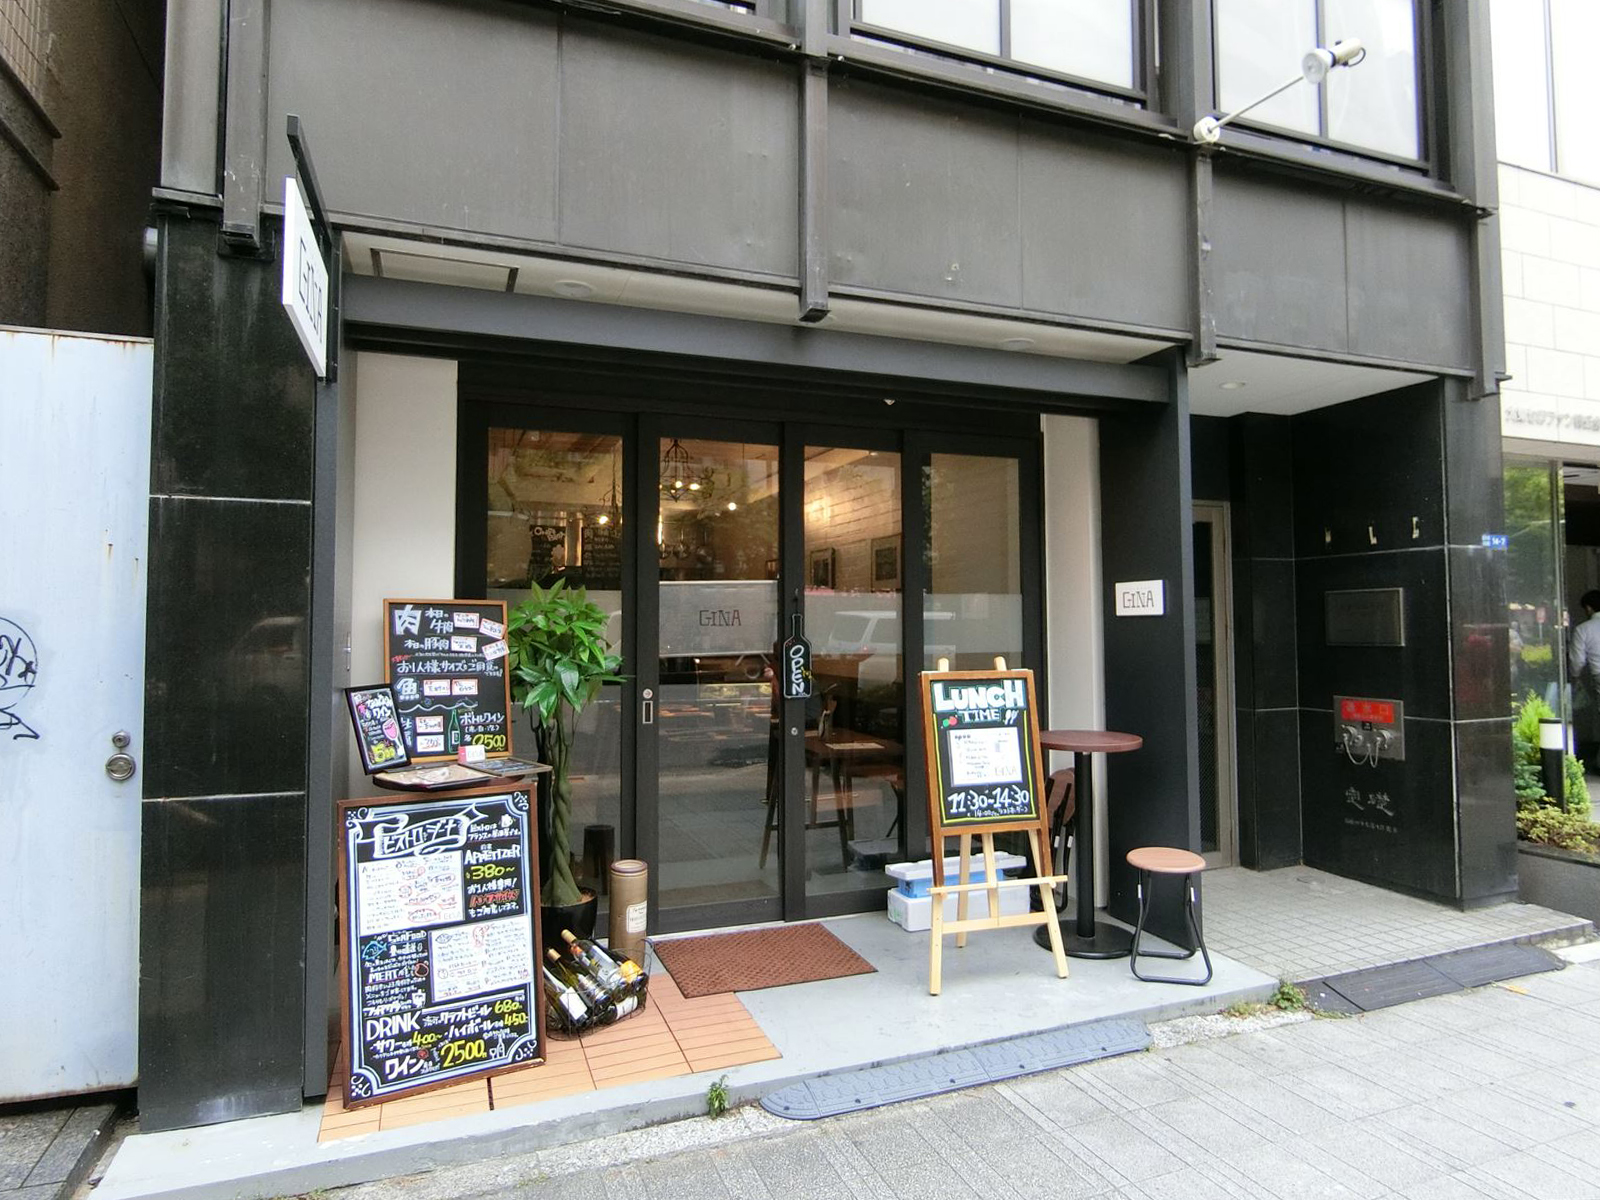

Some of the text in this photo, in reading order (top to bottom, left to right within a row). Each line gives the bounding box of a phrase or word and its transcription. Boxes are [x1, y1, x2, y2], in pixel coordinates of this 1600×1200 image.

[1122, 590, 1155, 608] GINA
[394, 604, 422, 635] 肉
[699, 609, 742, 627] GINA
[789, 644, 806, 696] OPEN
[396, 677, 420, 701] 魚
[932, 679, 1027, 712] LUNCH
[958, 709, 1001, 724] TIME
[464, 844, 521, 865] APPETIZER
[366, 1011, 421, 1041] DRINK
[385, 1055, 425, 1080] ワイン
